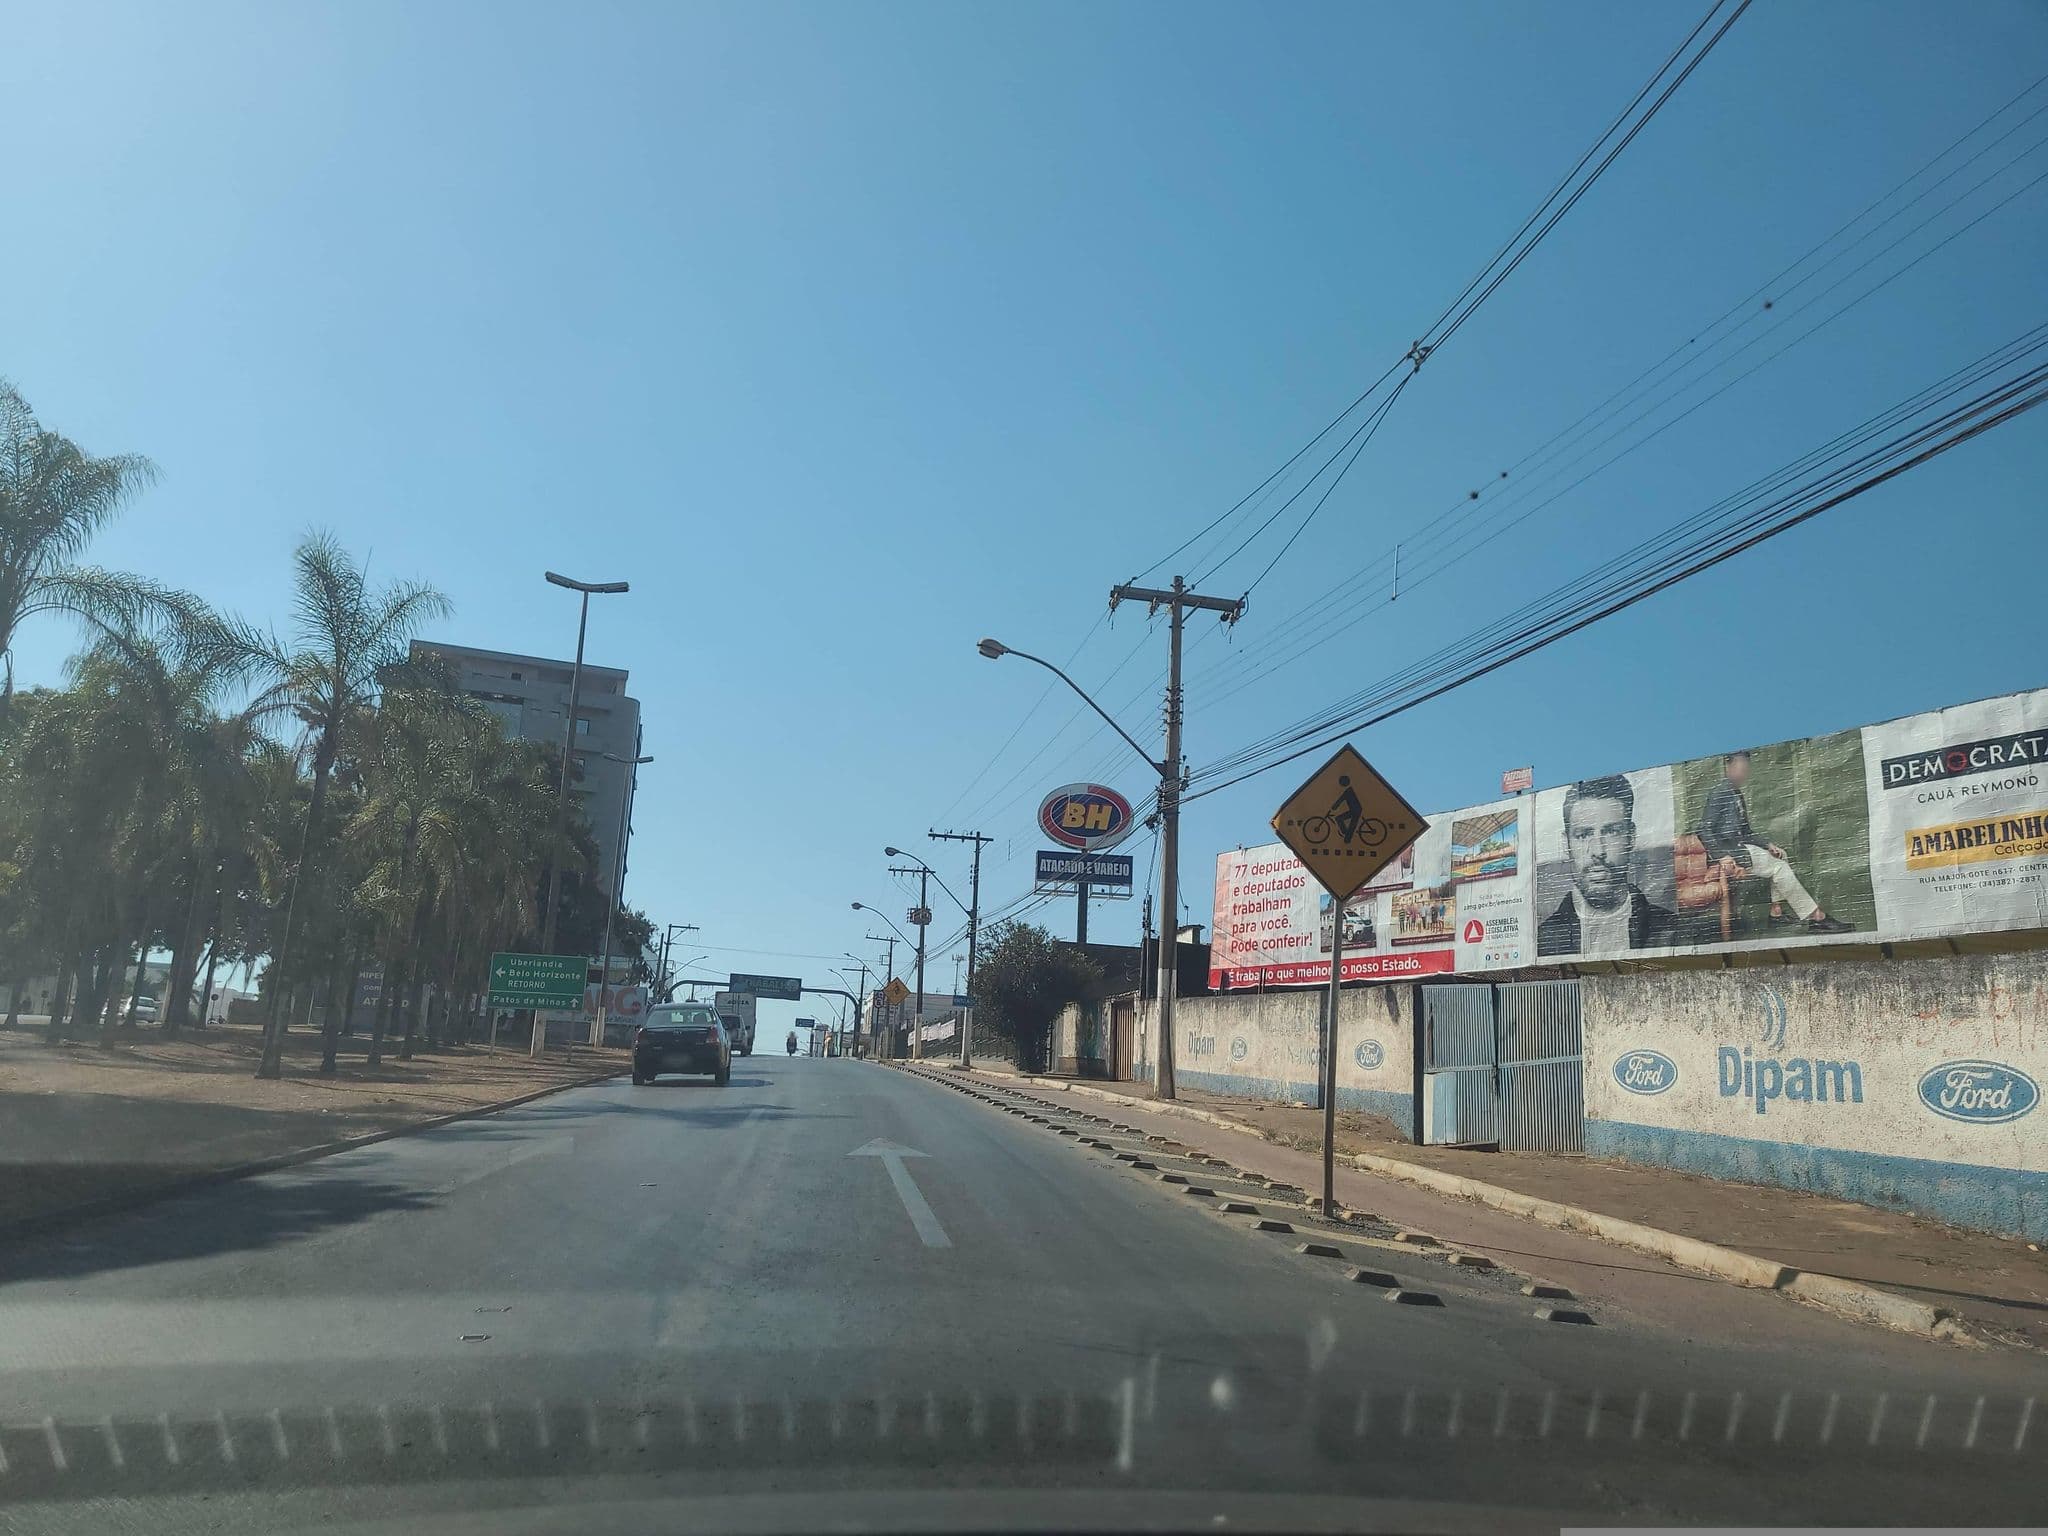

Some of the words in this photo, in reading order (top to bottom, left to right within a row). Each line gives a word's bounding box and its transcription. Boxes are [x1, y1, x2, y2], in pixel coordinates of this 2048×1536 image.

[1889, 736, 2048, 783] DEMOCRAT
[1961, 775, 2039, 796] REYMOND
[1062, 803, 1113, 830] BH
[1040, 859, 1084, 874] ATACADO
[1094, 862, 1130, 876] VAREJO
[1235, 863, 1248, 878] 77
[1919, 876, 1936, 884] RUA
[1938, 872, 1966, 882] MAJOR
[1233, 886, 1240, 897] e
[1243, 875, 1305, 896] deputados
[1233, 898, 1291, 916] trabalham
[1232, 922, 1257, 937] para
[1260, 914, 1292, 931] você.
[1486, 917, 1519, 927] ASSEMBLEIA
[1486, 924, 1519, 935] LEGISLATIVA
[1231, 939, 1258, 953] Pode
[1262, 932, 1313, 949] conferir!
[509, 969, 530, 977] Belo
[533, 970, 581, 980] Horizonte
[1228, 968, 1234, 982] É
[1277, 969, 1294, 981] que
[1341, 965, 1348, 974] o
[1350, 963, 1379, 974] nosso
[1382, 957, 1422, 972] Estado.
[508, 980, 546, 989] RETORNO
[493, 995, 520, 1004] Patos
[523, 997, 534, 1005] de
[537, 998, 567, 1006] Minas
[1188, 1030, 1215, 1061] Dipam
[1360, 1043, 1380, 1065] Ford
[1624, 1055, 1664, 1086] Ford
[1718, 1045, 1864, 1115] Dipam
[1940, 1069, 2013, 1110] Ford
